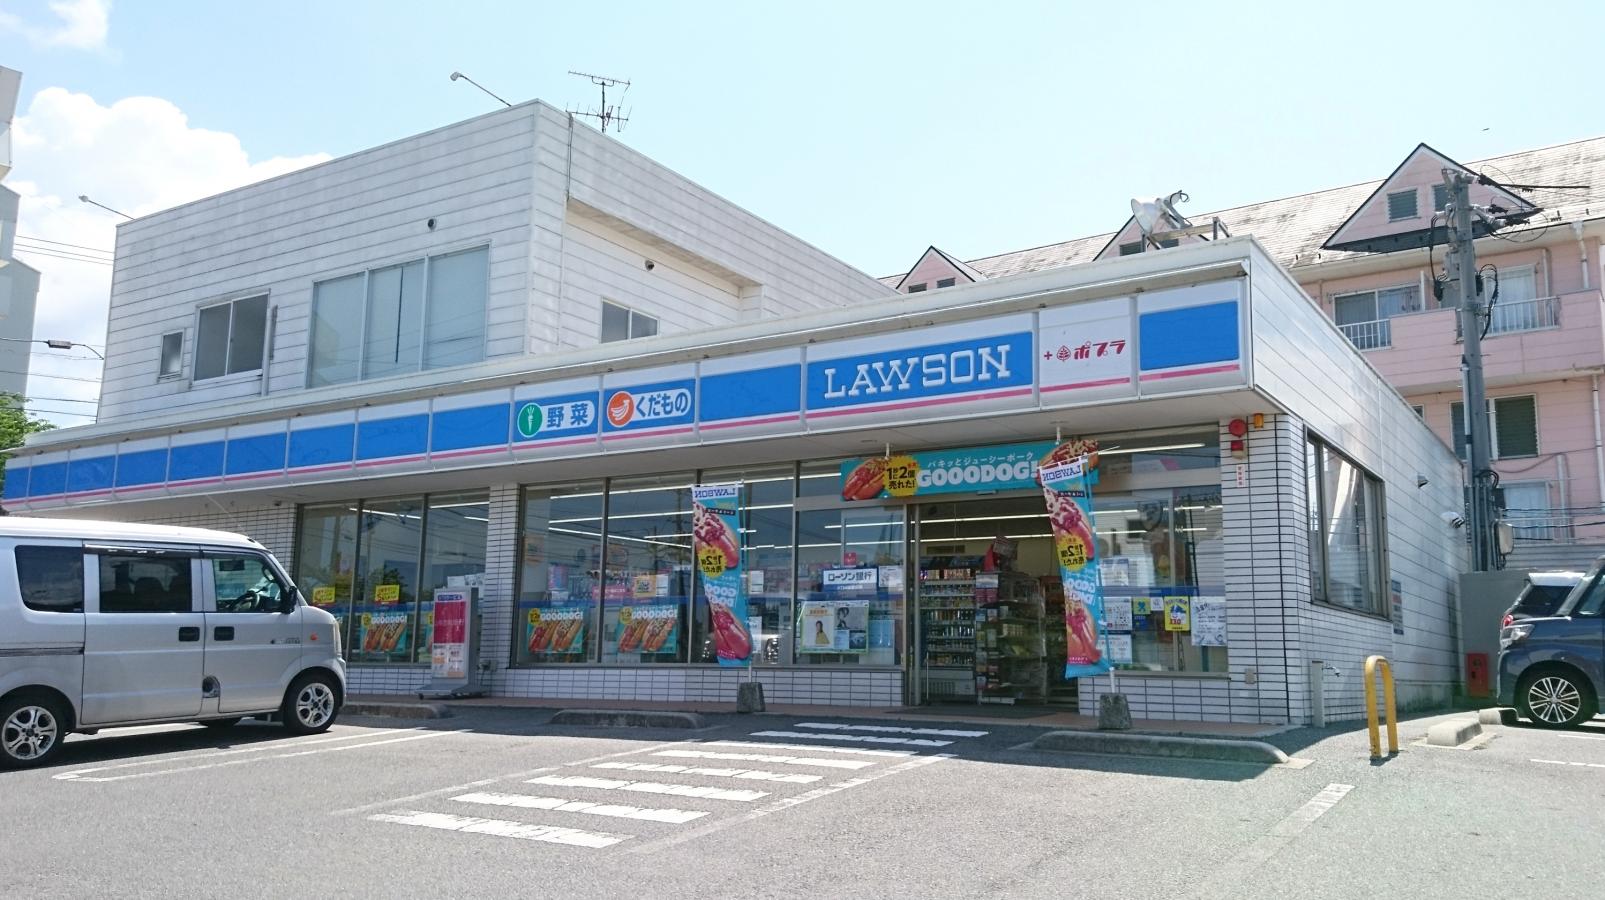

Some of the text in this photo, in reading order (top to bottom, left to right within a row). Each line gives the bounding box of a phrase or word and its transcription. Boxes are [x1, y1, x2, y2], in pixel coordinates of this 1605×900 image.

[1074, 339, 1126, 360] ポプラ
[824, 344, 1011, 400] LAWSON
[546, 402, 589, 428] 野菜
[636, 391, 689, 418] くだもの
[928, 451, 1034, 468] パキッとジューシーポーク
[888, 479, 916, 490] 売れた!
[916, 460, 1041, 488] GOOODOG!
[827, 570, 872, 582] ローソン銀行
